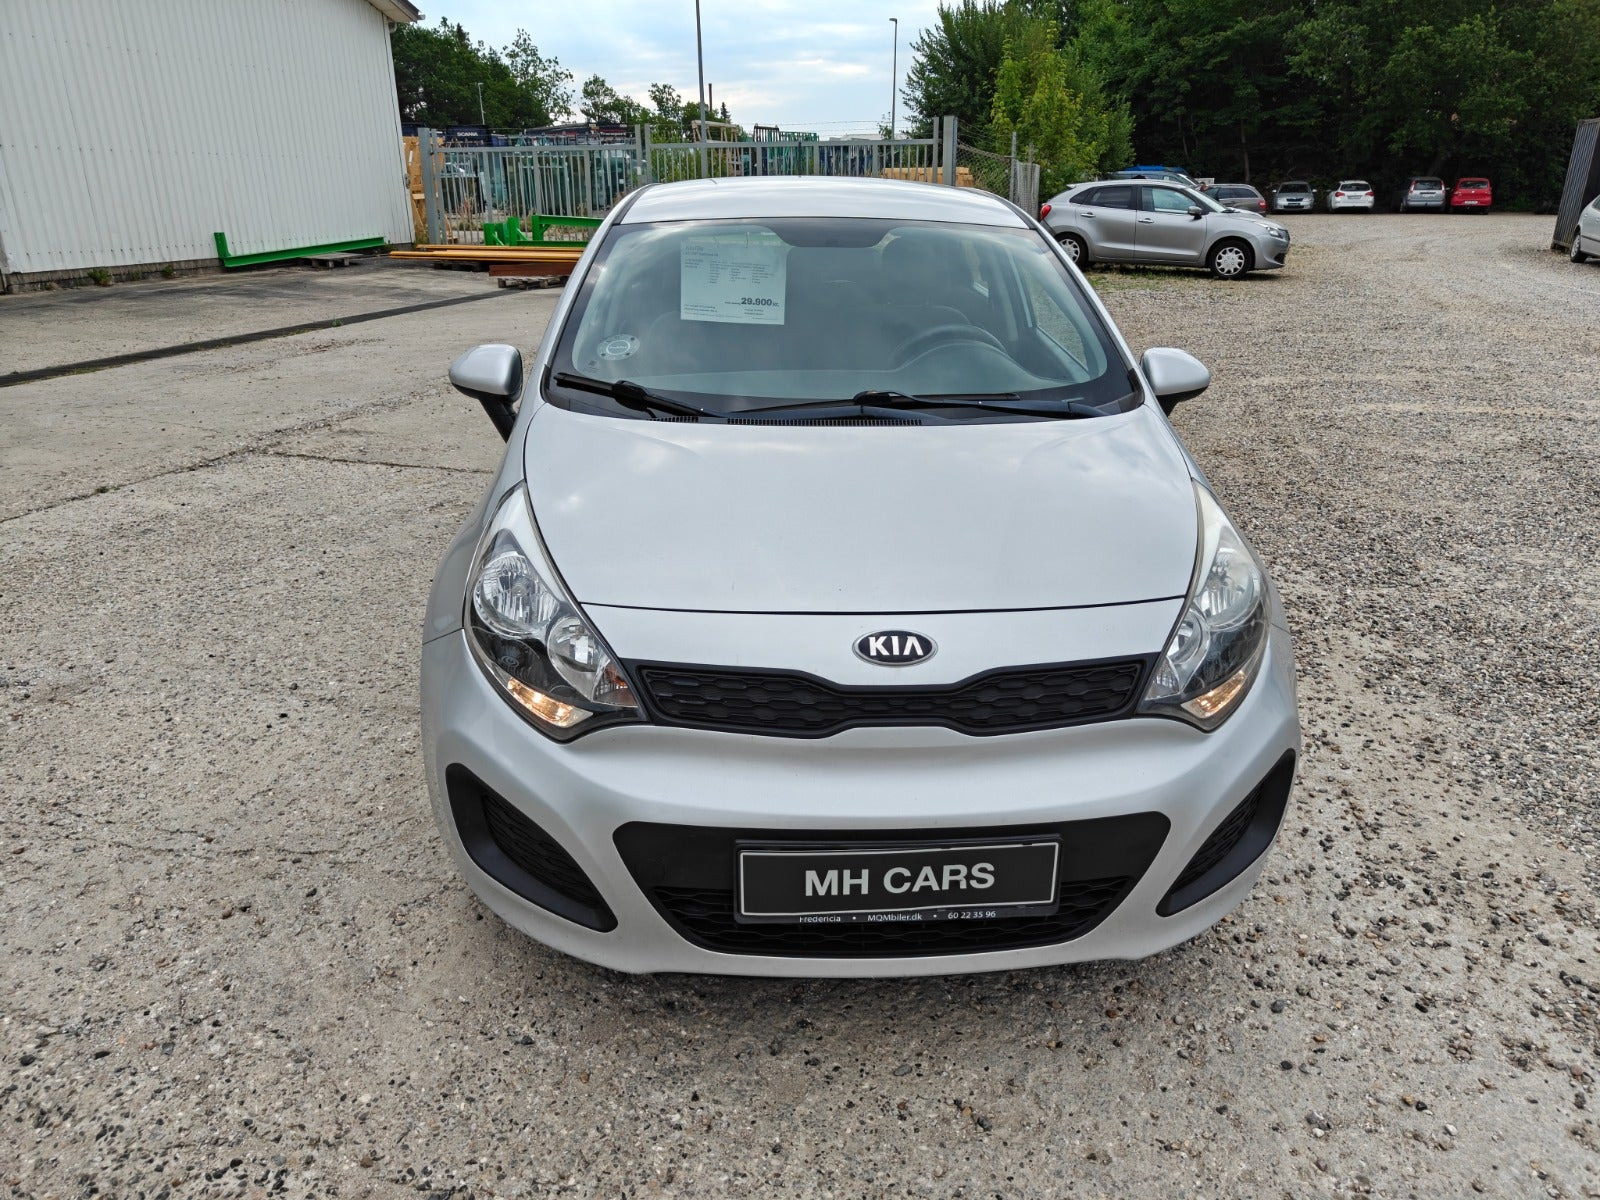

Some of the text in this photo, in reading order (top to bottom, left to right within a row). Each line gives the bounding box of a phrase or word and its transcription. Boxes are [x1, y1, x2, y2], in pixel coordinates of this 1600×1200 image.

[741, 297, 772, 306] 29.900
[868, 635, 924, 656] KIA
[805, 862, 996, 897] MH CARS
[799, 910, 997, 923] Fredericia MQMbiler.dk 60 22 35 96
